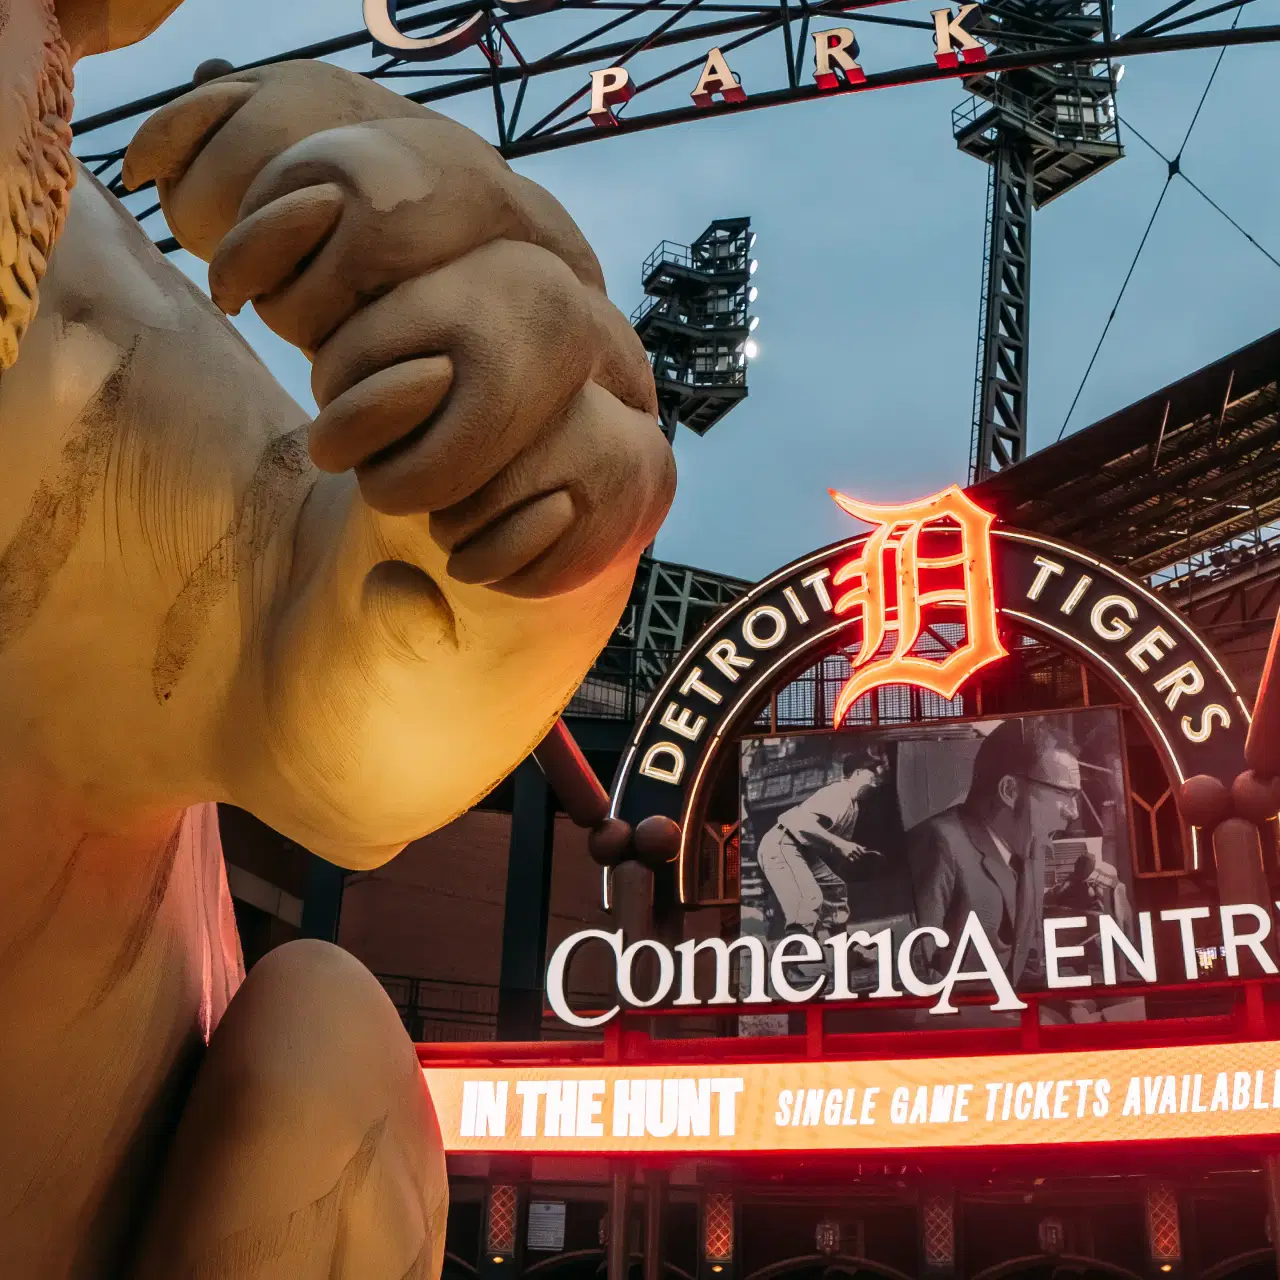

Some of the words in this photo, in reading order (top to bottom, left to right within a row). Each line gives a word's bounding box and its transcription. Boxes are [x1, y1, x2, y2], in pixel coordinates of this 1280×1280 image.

[587, 3, 987, 128] PARK
[639, 567, 834, 785] DETROIT
[1026, 554, 1232, 743] TIGERS
[458, 1080, 508, 1137] IN
[516, 1079, 606, 1138] THE
[612, 1077, 744, 1138] HUNT
[774, 1086, 877, 1127] SINGLE
[889, 1083, 972, 1125] GAME
[984, 1077, 1111, 1121] TICKETS
